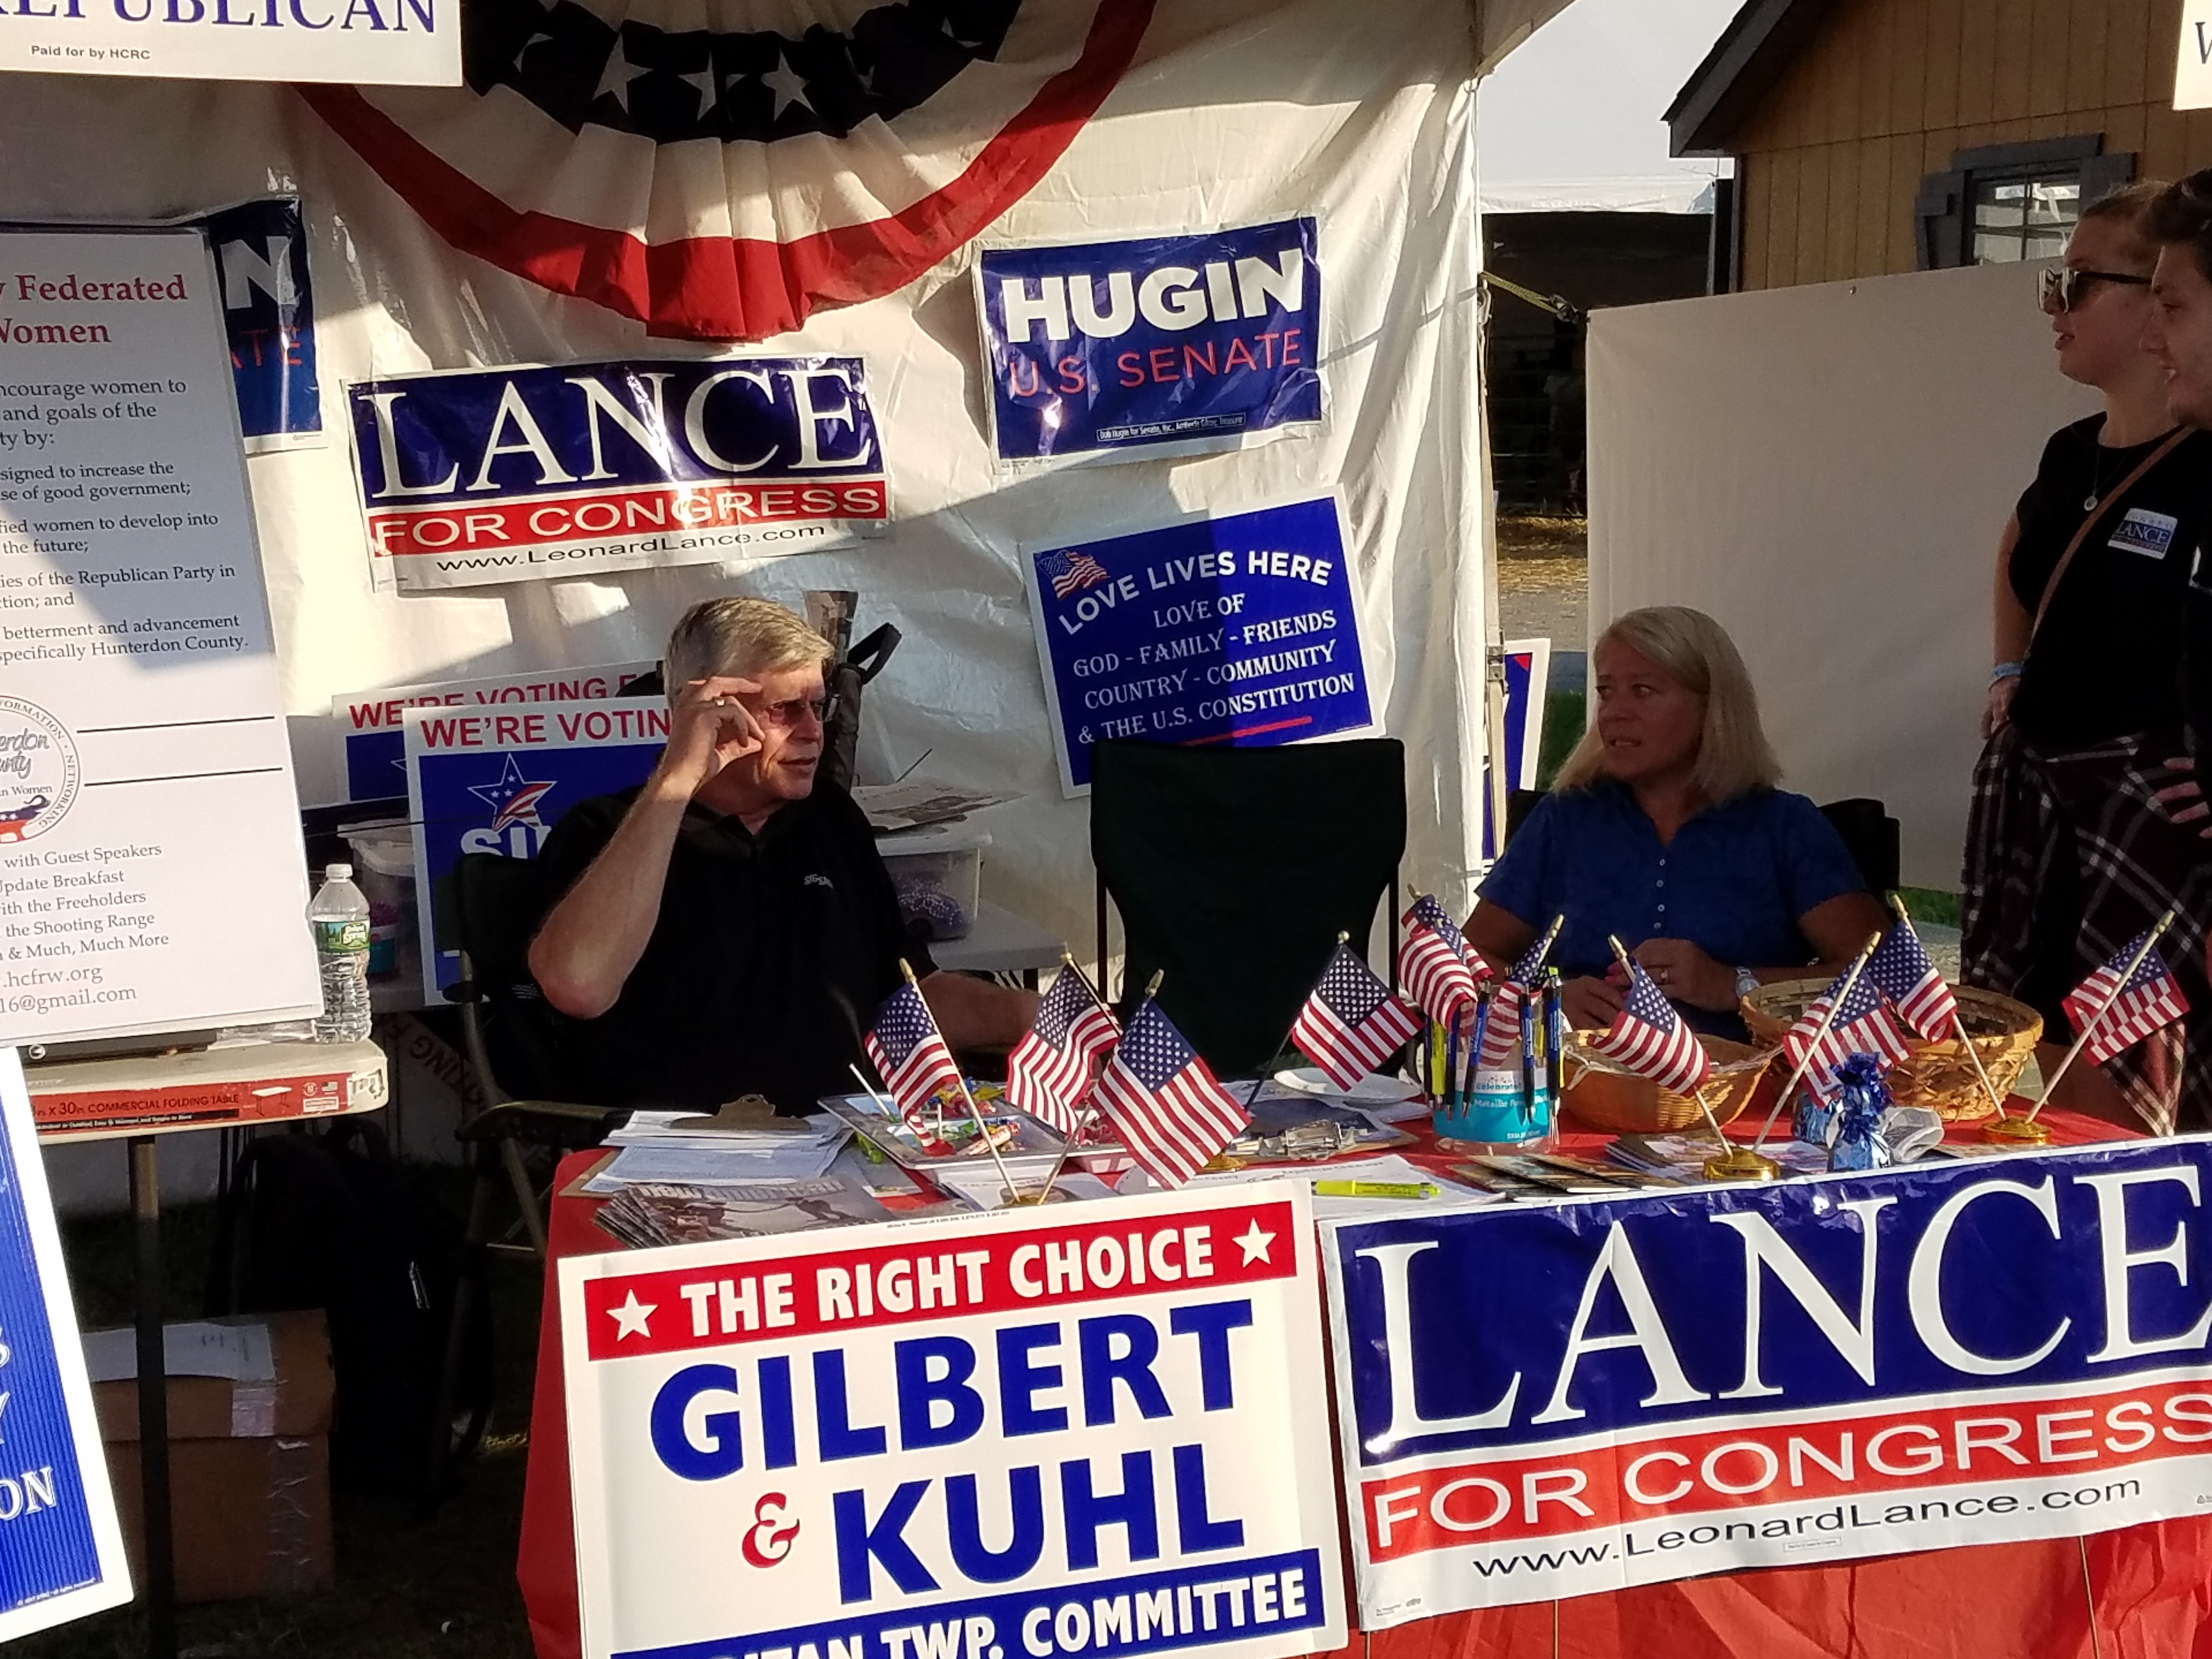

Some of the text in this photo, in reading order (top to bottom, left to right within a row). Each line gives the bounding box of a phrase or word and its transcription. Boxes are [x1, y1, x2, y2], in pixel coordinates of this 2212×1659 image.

[31, 45, 150, 60] Paid for by HCRC
[15, 274, 188, 301] Federated
[1002, 248, 1304, 343] HUGIN
[1009, 329, 1302, 397] U.S. SENATE
[92, 380, 162, 395] women
[168, 379, 186, 393] to
[3, 401, 157, 426] and goals of the
[22, 429, 55, 450] by:
[357, 368, 871, 499] LANCE
[60, 465, 76, 479] to
[79, 464, 145, 478] increase
[149, 461, 174, 475] the
[22, 485, 39, 500] of
[44, 484, 84, 503] good
[89, 480, 191, 502] government;
[33, 521, 94, 533] women
[99, 517, 115, 530] to
[119, 514, 183, 531] develop
[187, 512, 219, 526] into
[374, 488, 881, 555] FOR CONGRESS
[3, 539, 89, 554] the future;
[436, 524, 825, 573] www.LeonardLance.com
[27, 572, 43, 586] of
[49, 571, 75, 585] the
[78, 567, 168, 587] Republican
[172, 566, 215, 583] Party
[219, 564, 236, 578] in
[0, 592, 75, 609] tion; and
[1059, 550, 1332, 635] LOVE LIVES HERE
[1153, 593, 1245, 629] LOVE OF
[3, 615, 240, 640] betterment and advancement
[0, 635, 249, 665] pecifically Hunterdon County.
[1074, 653, 1120, 677] GOD
[1139, 628, 1224, 665] FAMILY
[1243, 610, 1337, 646] FRIENDS
[1085, 669, 1188, 709] COUNTRY
[1207, 639, 1337, 685] COMMUNITY
[476, 678, 607, 705] VOTING
[1078, 673, 1355, 744] & THE U.S. CONSTITUTION
[420, 708, 670, 748] WE'RE VOTIN
[10, 785, 53, 795] Women
[39, 754, 76, 828] NETWORKING
[4, 844, 162, 868] with Guest Speakers
[53, 870, 125, 887] Breakfast
[0, 891, 146, 915] ith the Freeholders
[6, 913, 155, 938] the Shooting Range
[8, 933, 170, 960] & Much, Much More
[88, 1099, 160, 1113] COMMERCIAL
[163, 1096, 209, 1108] FOLDING
[212, 1094, 239, 1104] TABLE
[680, 1225, 1214, 1337] THE RIGHT CHOICE
[1355, 1164, 2212, 1454] LANCE
[650, 1298, 1254, 1482] GILBERT
[1374, 1392, 2212, 1548] FOR CONGRESS
[741, 1443, 1245, 1605] & KUHL
[1471, 1476, 2142, 1579] www.LeonardLance.com
[881, 1568, 1307, 1659] TWP. COMMITTEE
